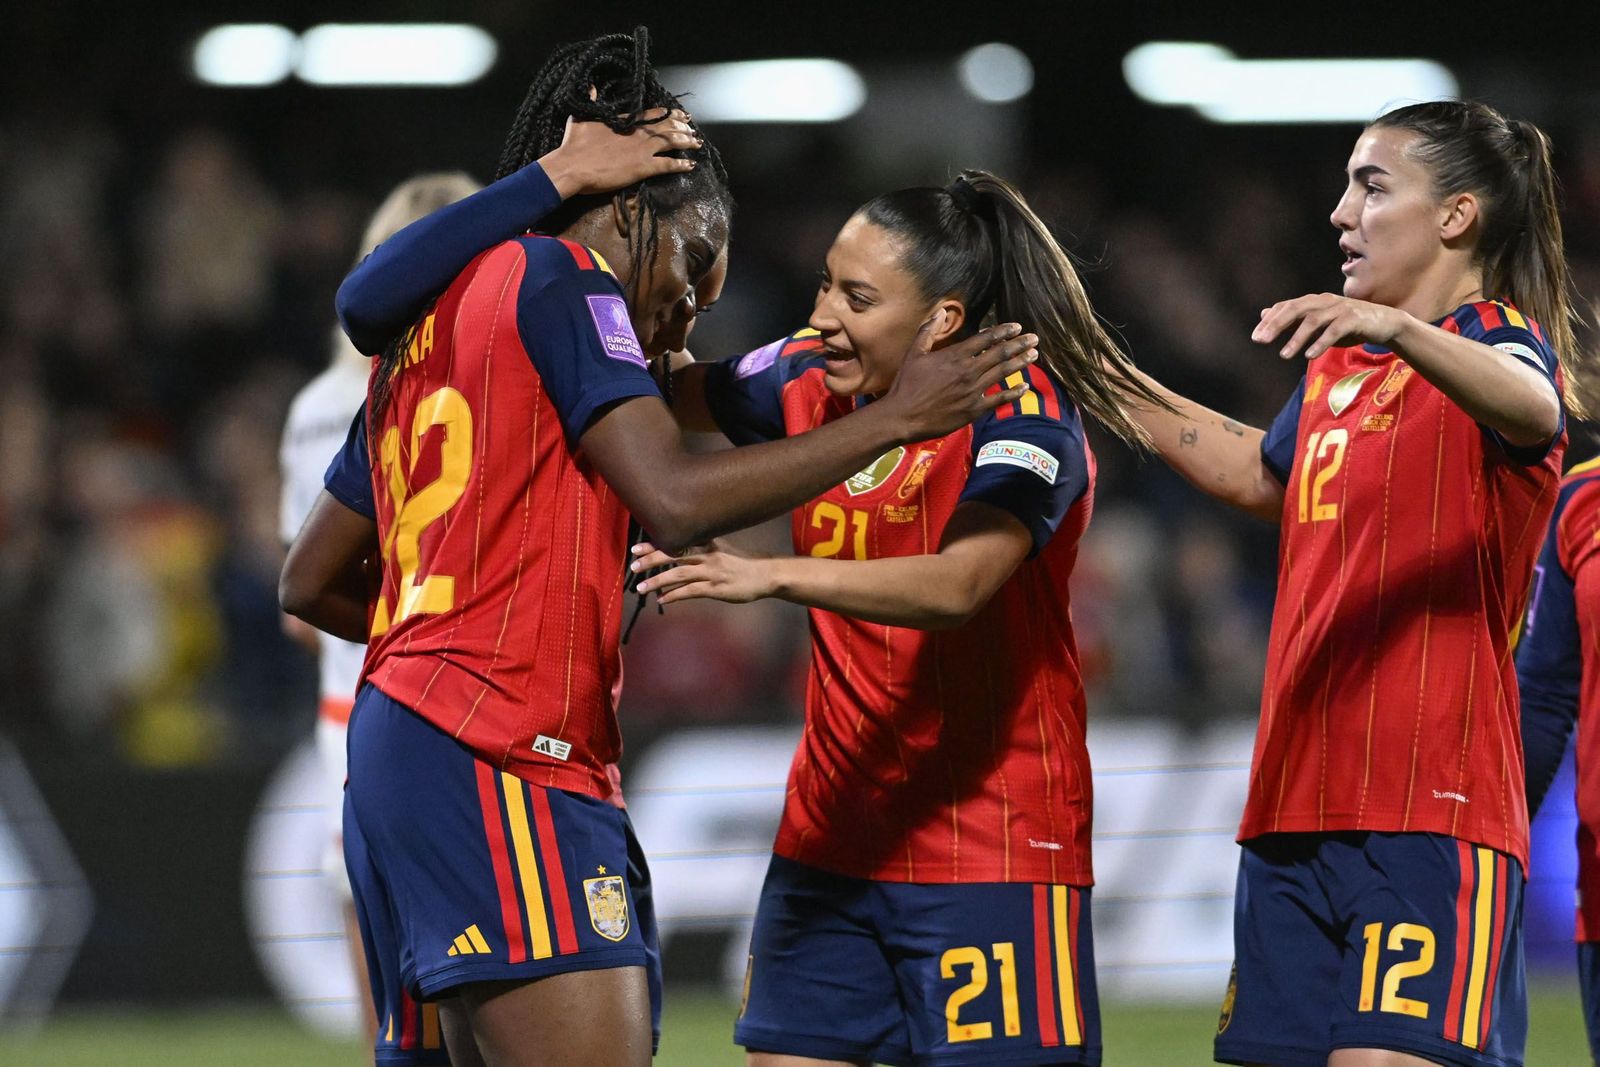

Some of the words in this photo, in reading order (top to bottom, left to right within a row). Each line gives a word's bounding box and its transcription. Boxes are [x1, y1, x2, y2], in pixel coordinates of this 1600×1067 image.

[980, 447, 1056, 475] FOUNDATION
[1298, 428, 1349, 523] 12
[811, 501, 869, 560] 21
[941, 942, 1021, 1043] 21
[1358, 922, 1436, 1019] 12
